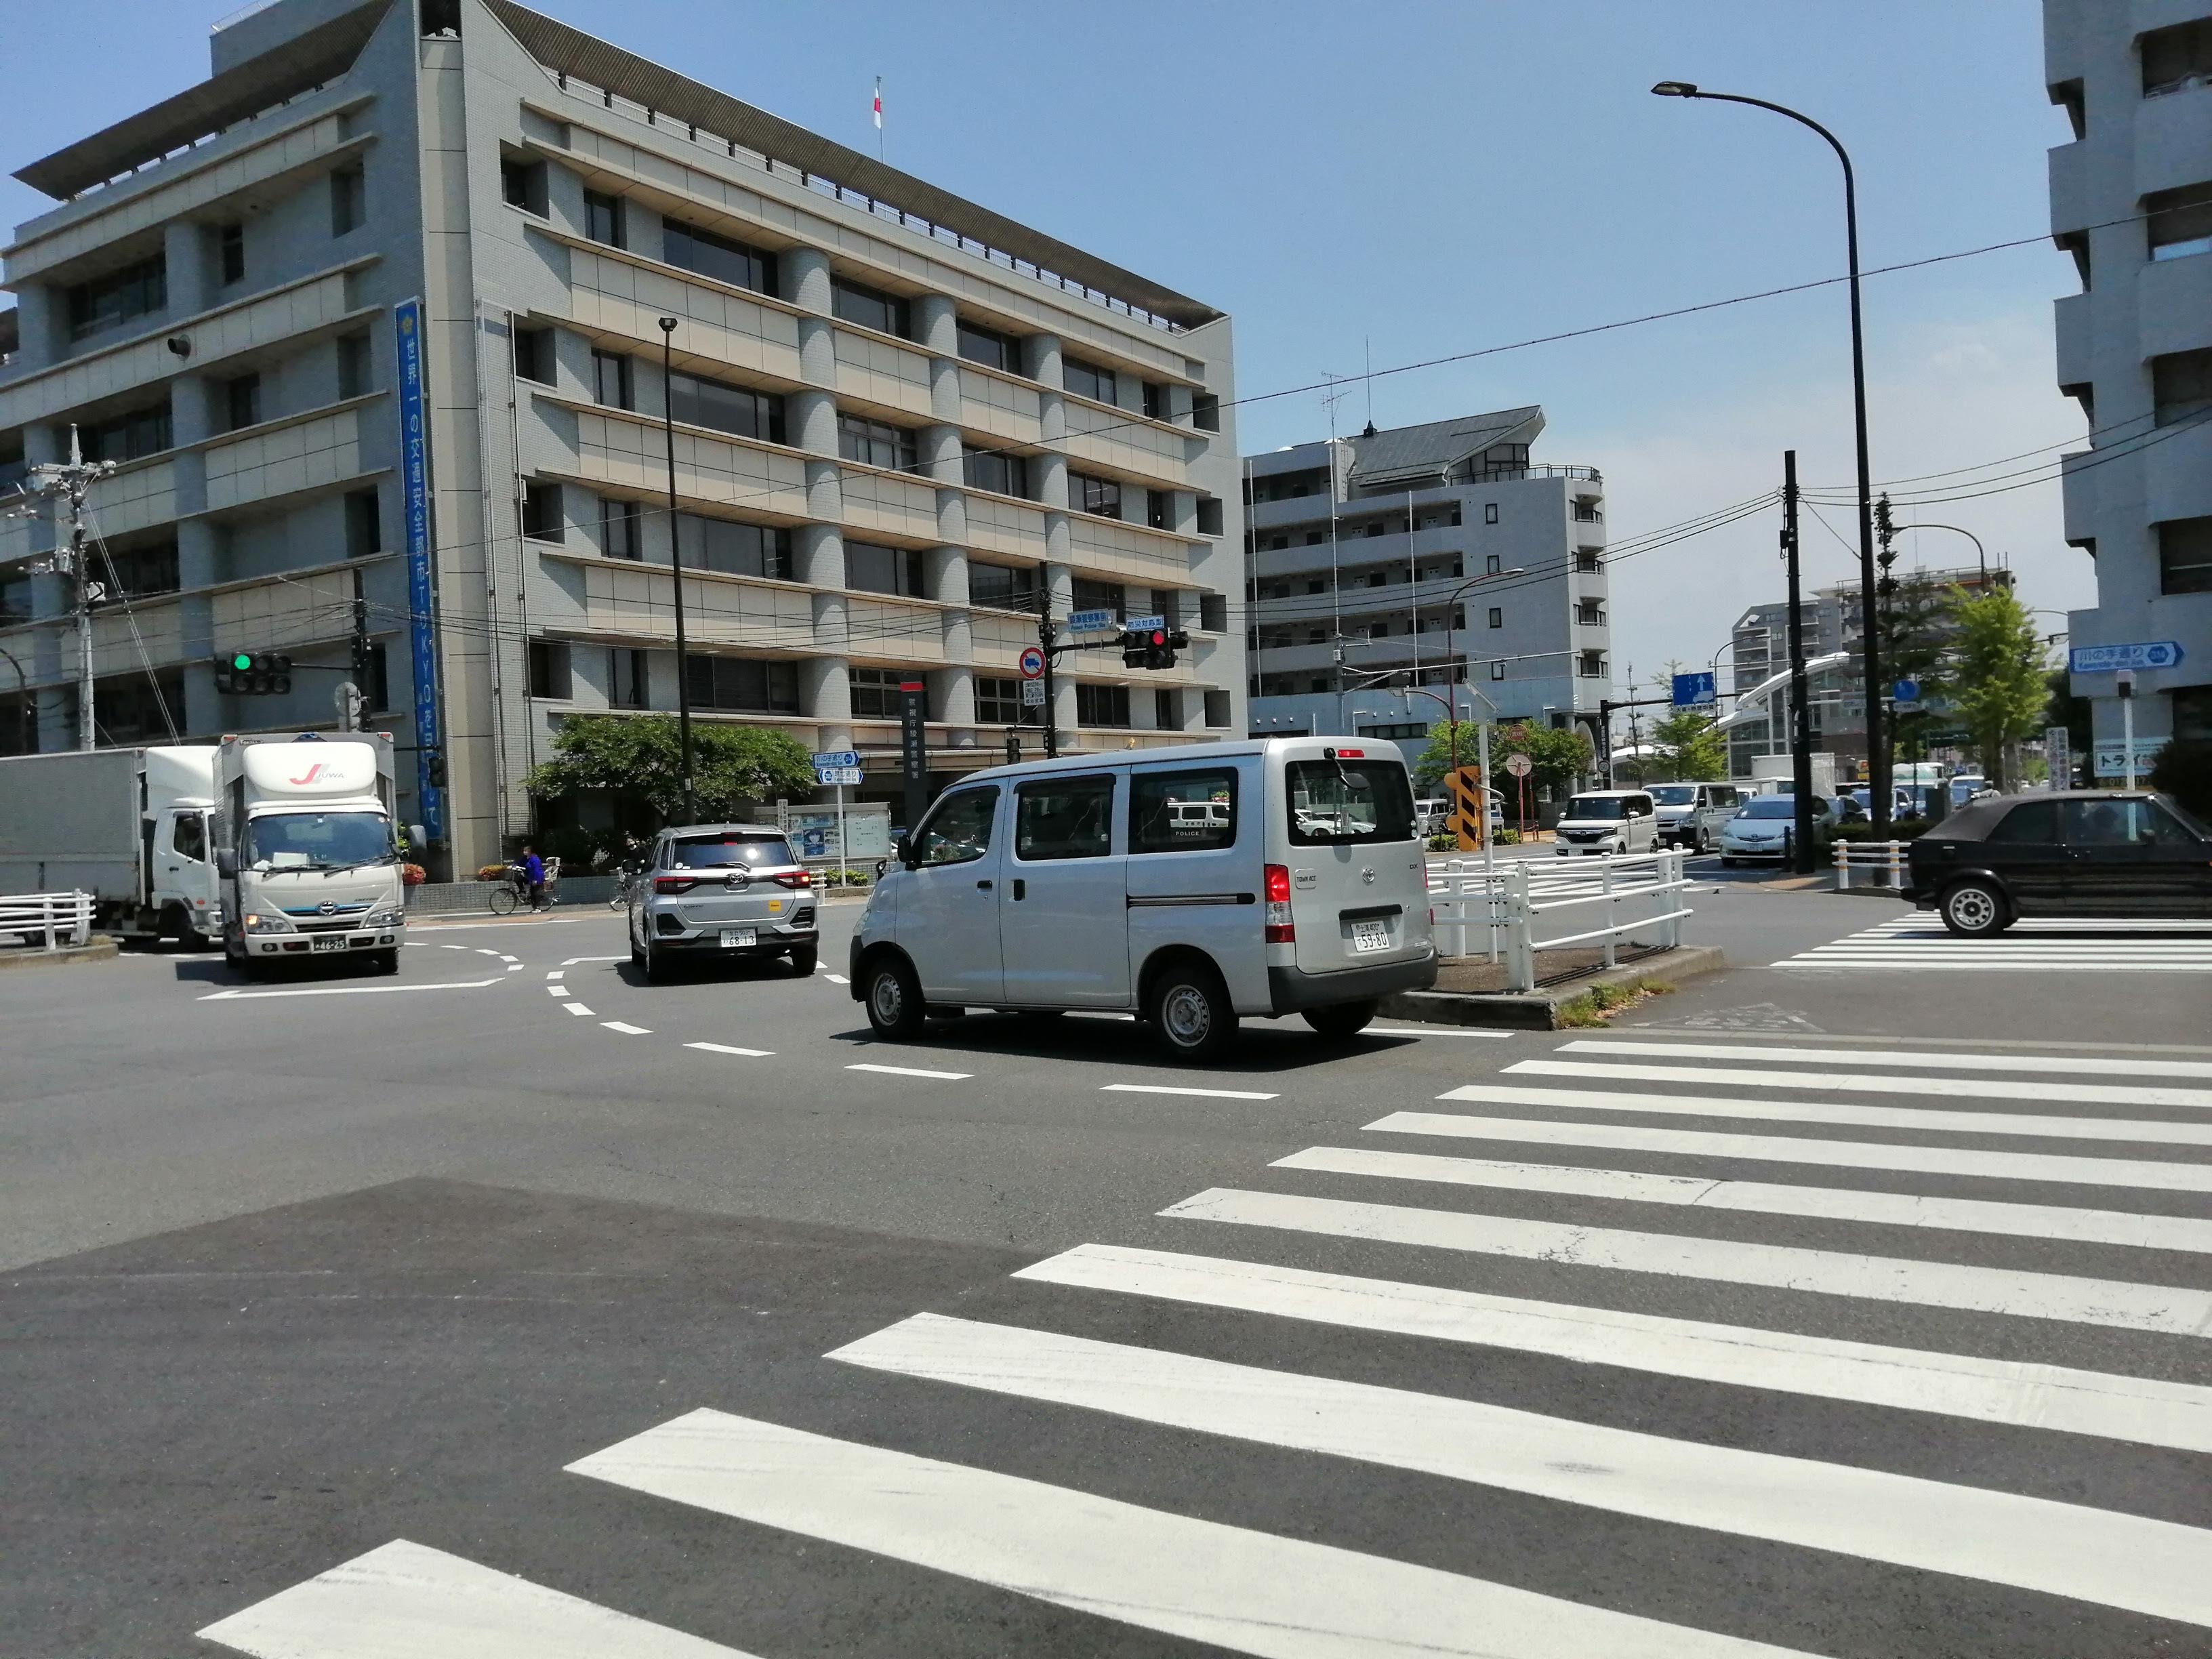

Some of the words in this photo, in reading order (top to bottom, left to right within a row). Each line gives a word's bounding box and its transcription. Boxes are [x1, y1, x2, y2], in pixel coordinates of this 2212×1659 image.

[1128, 618, 1162, 628] 防災対応型
[2080, 646, 2144, 661] 川の手通り
[908, 698, 919, 779] 警視庁綾瀬警察署
[320, 941, 345, 949] 46-25
[729, 935, 754, 945] 68-13
[1361, 933, 1387, 949] 59-80
